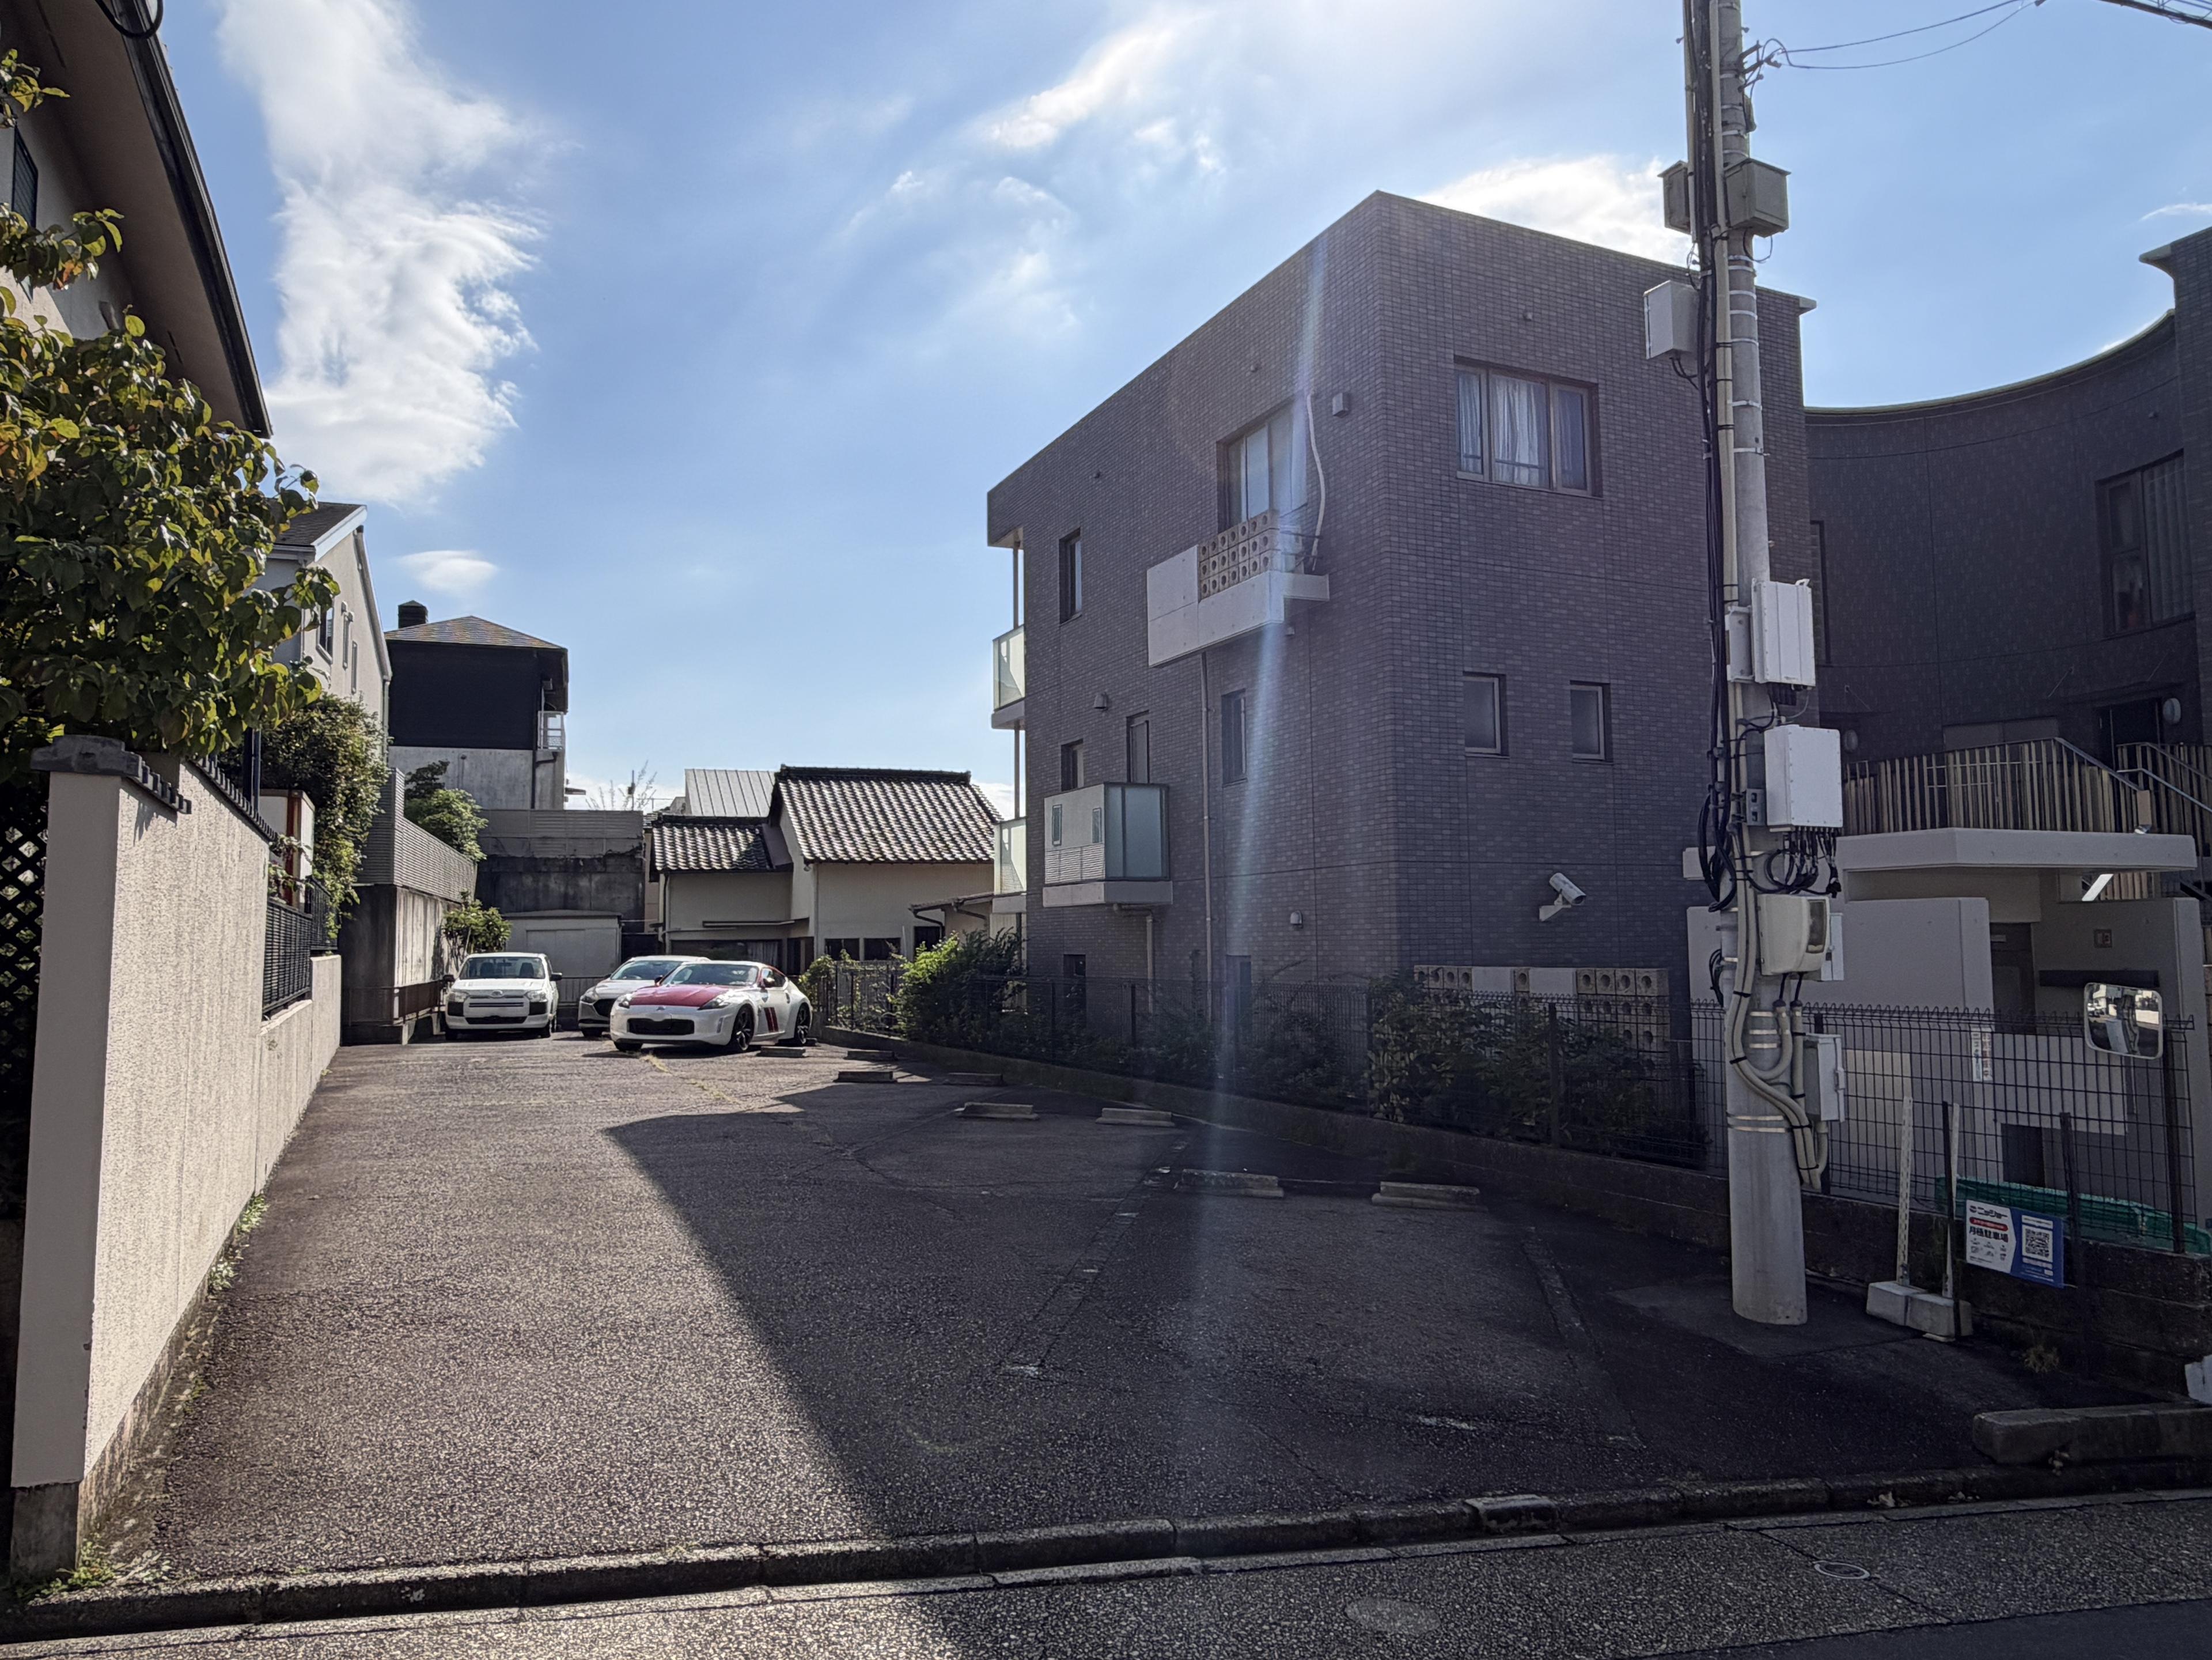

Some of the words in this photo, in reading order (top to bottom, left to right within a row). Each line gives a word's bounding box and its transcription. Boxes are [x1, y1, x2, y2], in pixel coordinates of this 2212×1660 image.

[1969, 1226, 2009, 1242] 月極駐車場
